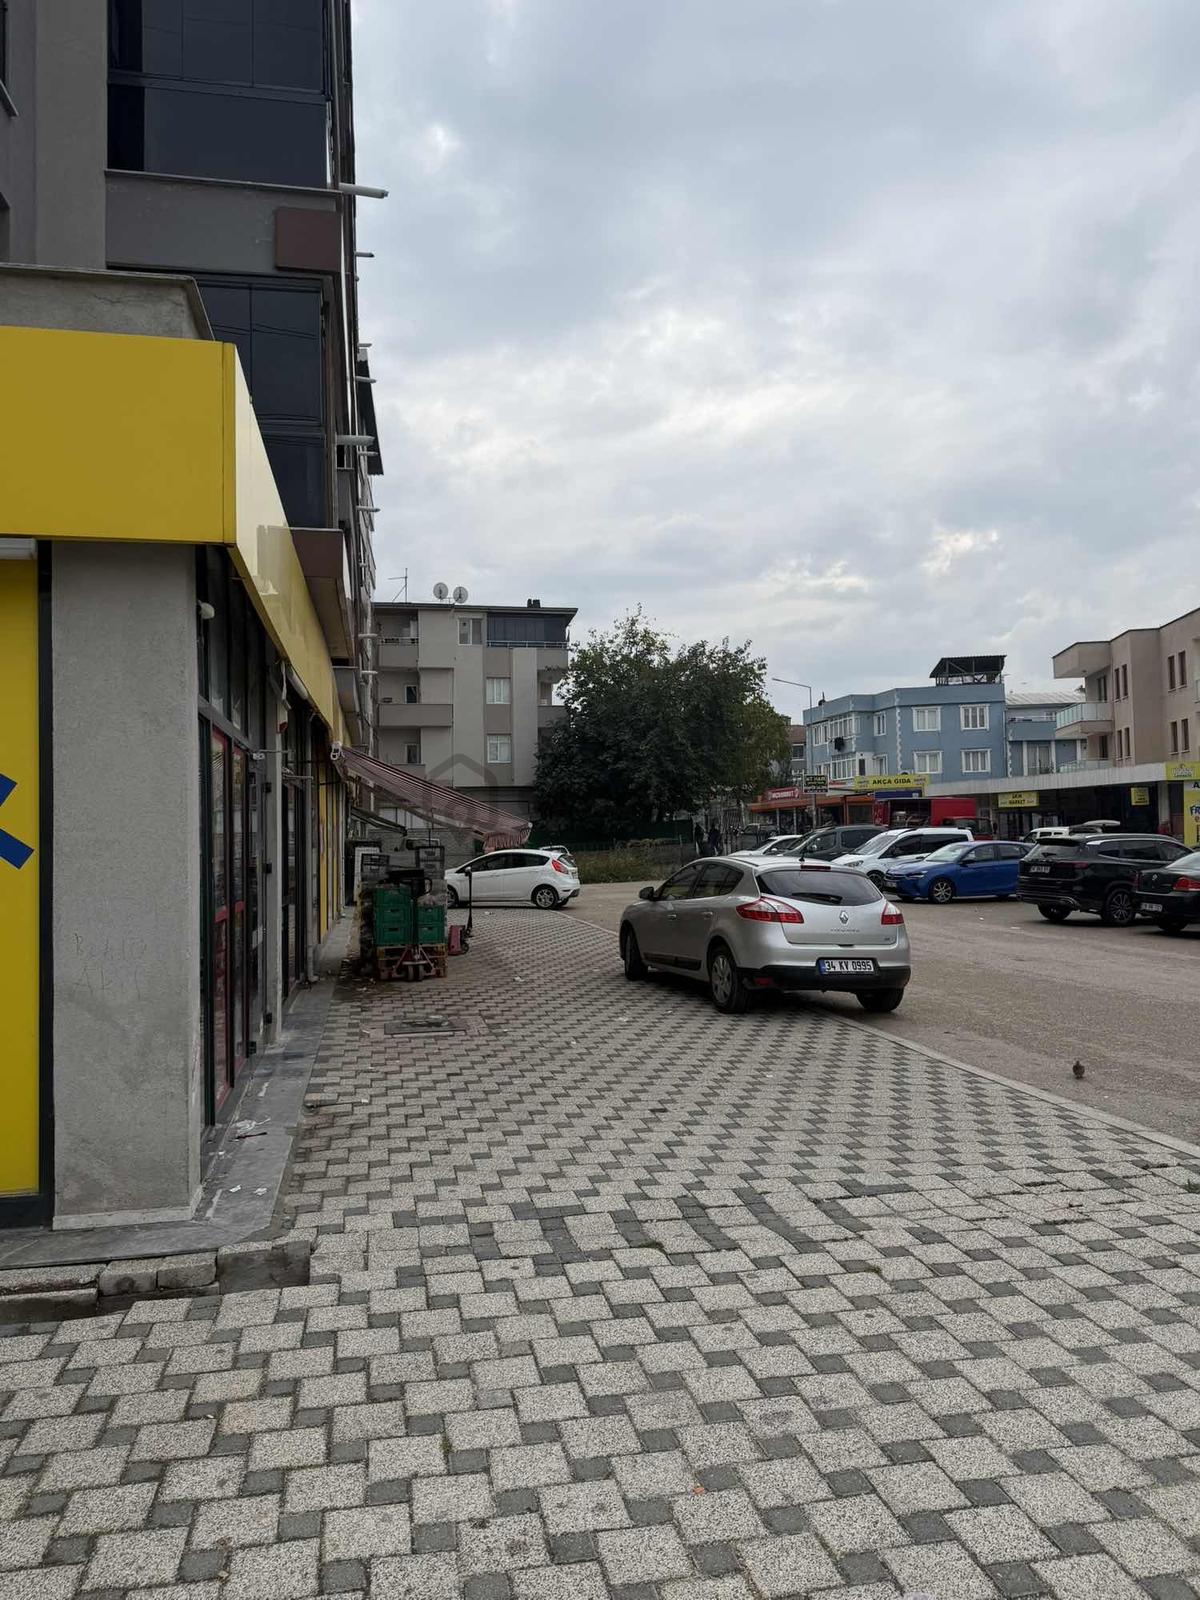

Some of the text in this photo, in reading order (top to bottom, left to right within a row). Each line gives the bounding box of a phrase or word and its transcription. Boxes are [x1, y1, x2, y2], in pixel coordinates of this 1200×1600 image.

[825, 960, 872, 971] 34 KV 0995
